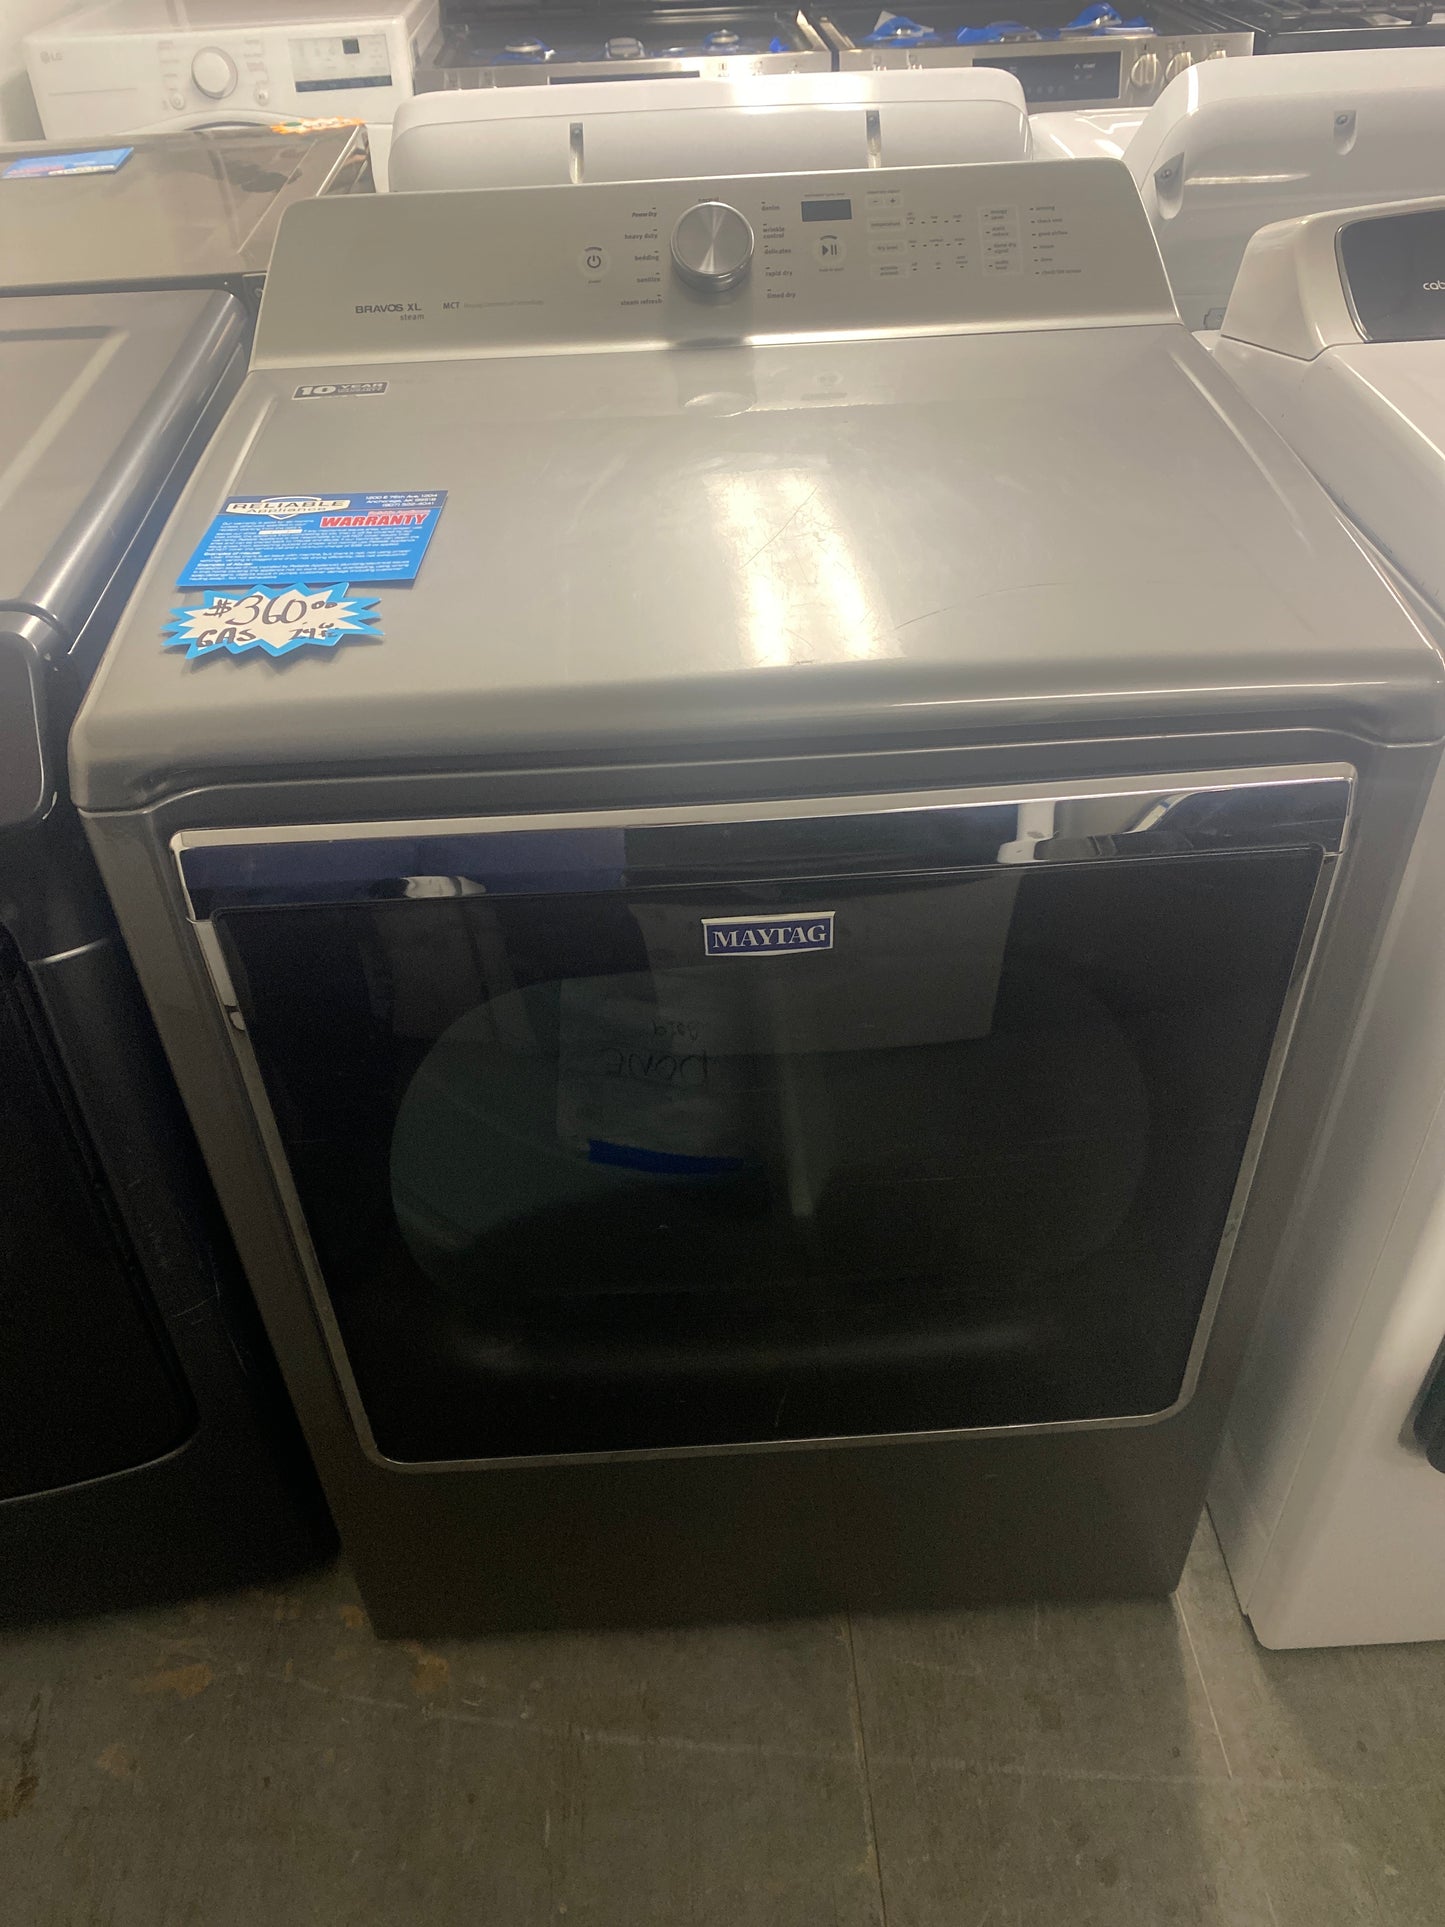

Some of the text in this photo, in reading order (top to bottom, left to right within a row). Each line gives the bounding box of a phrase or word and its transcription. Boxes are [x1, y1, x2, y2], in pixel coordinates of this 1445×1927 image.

[355, 303, 422, 314] BRAVOS XL
[443, 302, 460, 310] MCT
[301, 386, 337, 395] 10
[232, 501, 343, 510] RELIABLE
[320, 513, 427, 528] WARRANTY
[196, 627, 257, 648] GAS
[713, 924, 828, 948] MAYTAG
